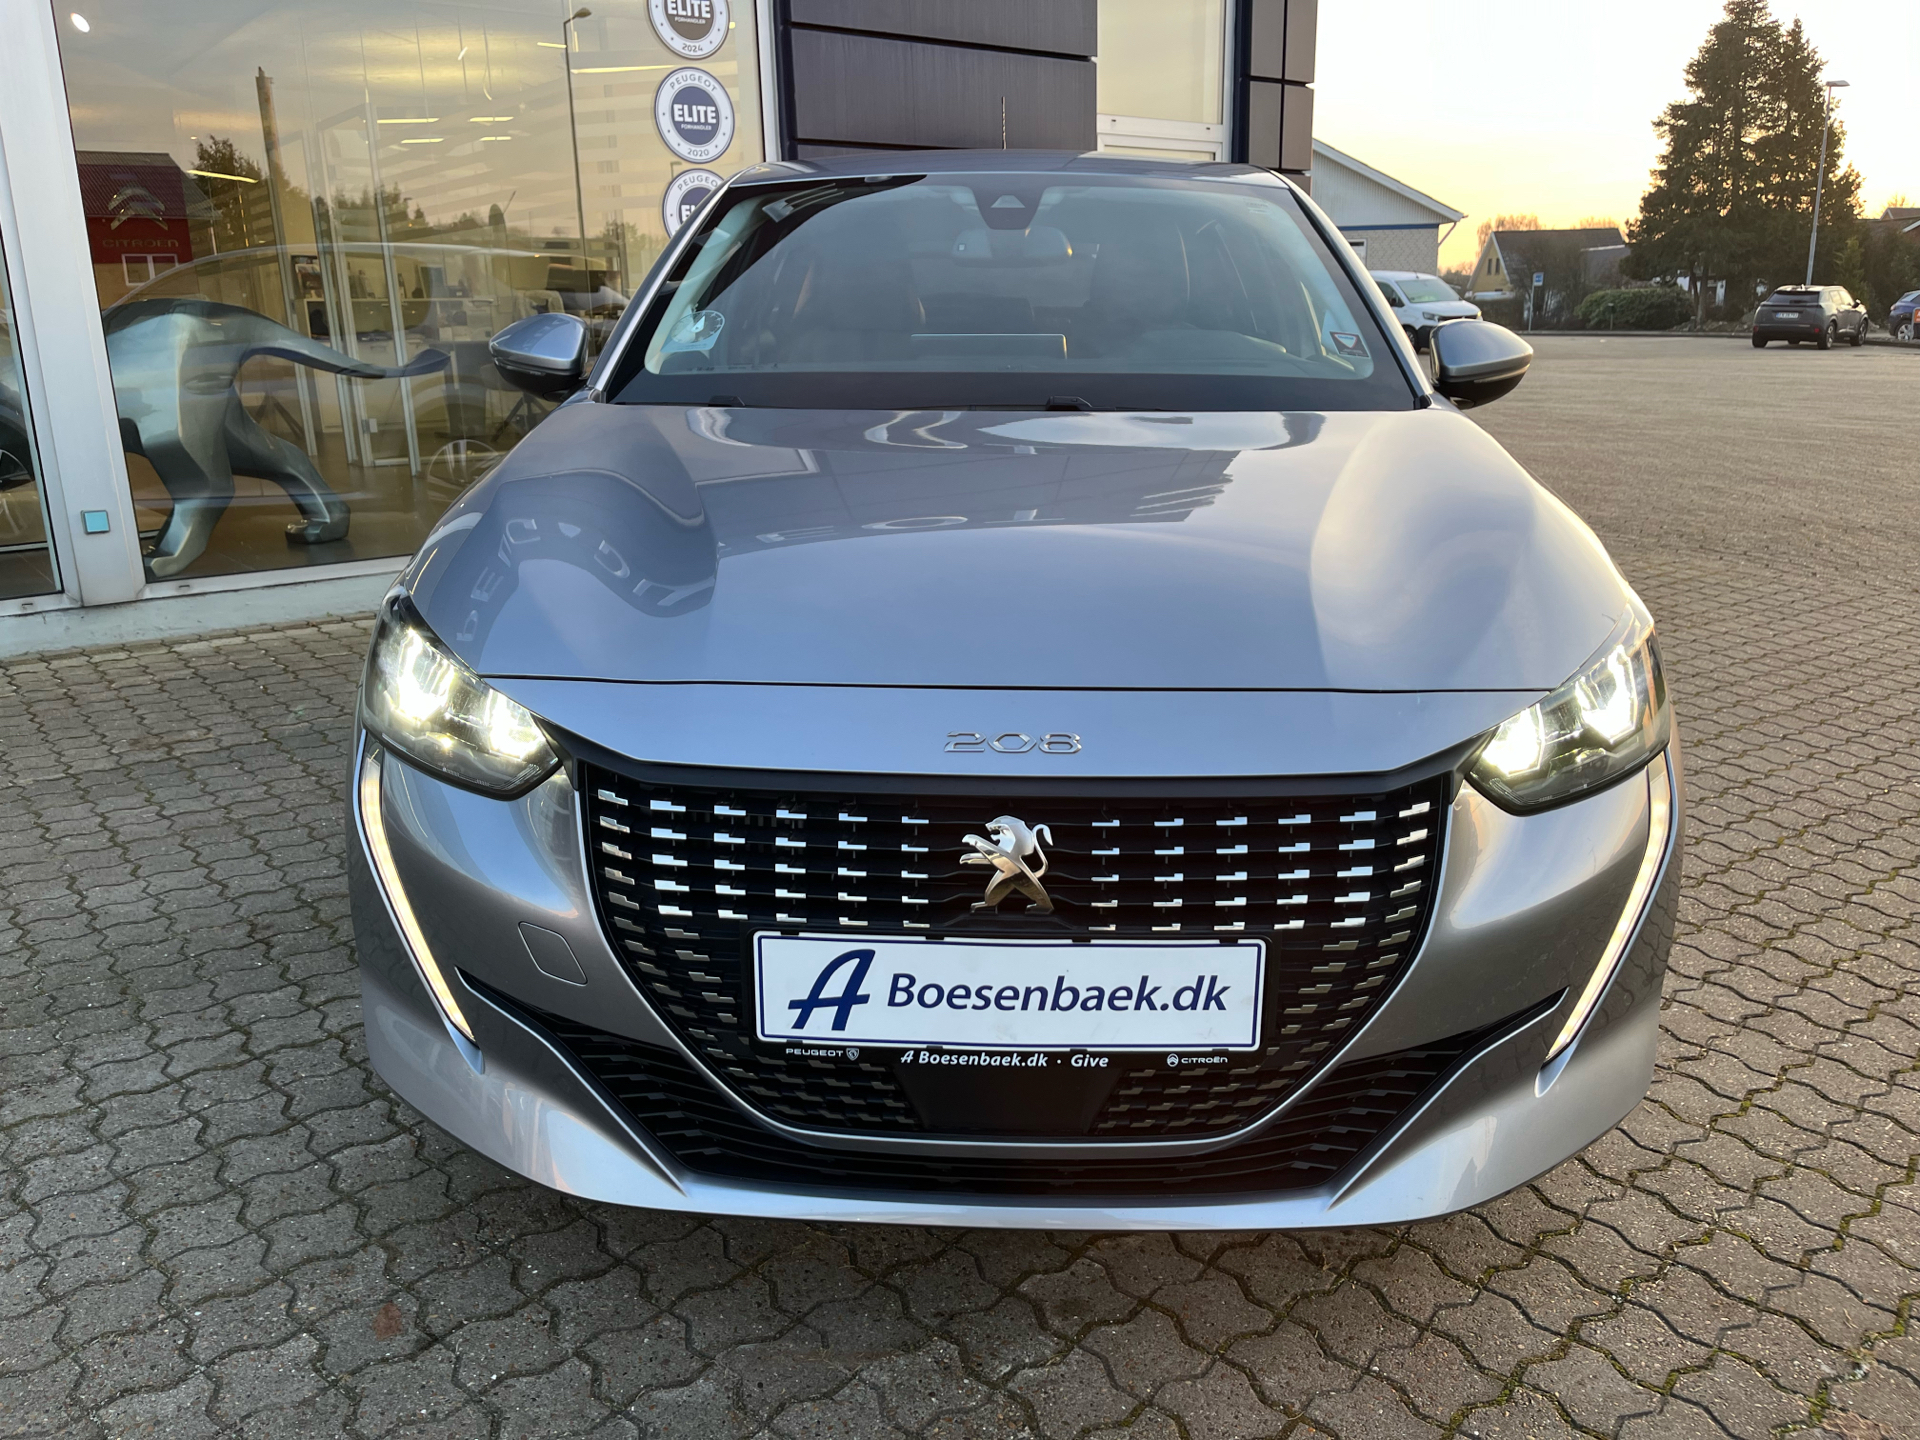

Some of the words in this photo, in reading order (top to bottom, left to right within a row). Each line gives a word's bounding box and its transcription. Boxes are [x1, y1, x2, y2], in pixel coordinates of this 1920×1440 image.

[667, 0, 711, 19] ELITE
[681, 43, 704, 53] 2024
[669, 73, 718, 92] PEUGEOT
[673, 104, 717, 124] ELITE
[687, 148, 710, 157] 2020
[677, 174, 719, 191] PEUGEO
[944, 731, 1082, 754] 208
[887, 972, 1231, 1013] Boesenbaek.dk
[785, 1048, 844, 1057] PEUGEOT
[900, 1050, 915, 1064] A
[918, 1051, 1048, 1067] Boesenbaek.dk
[1070, 1053, 1109, 1067] Give
